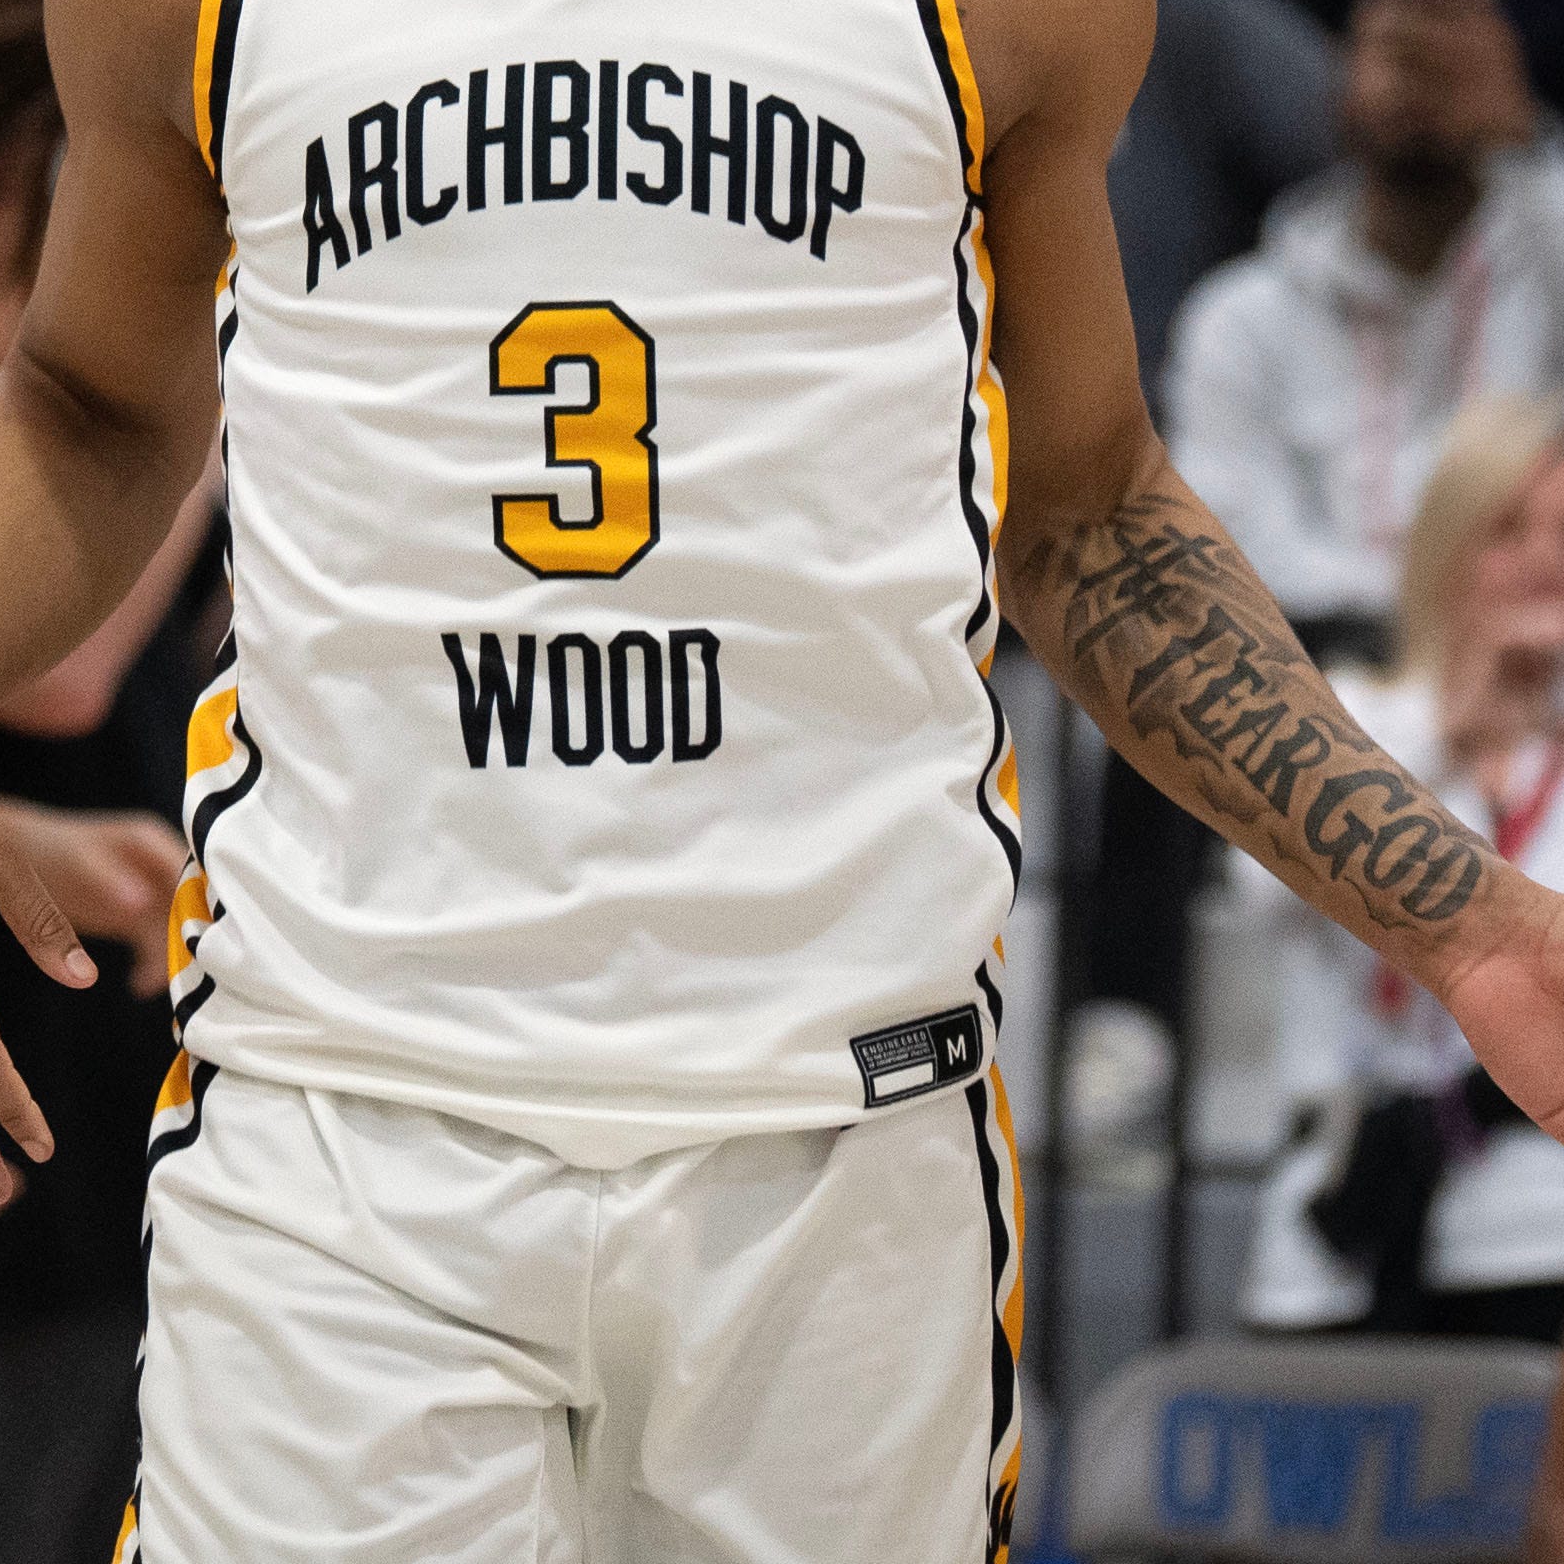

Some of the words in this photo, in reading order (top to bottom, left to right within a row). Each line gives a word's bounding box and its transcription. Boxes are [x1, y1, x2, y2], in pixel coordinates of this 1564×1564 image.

[303, 60, 865, 294] ARCHBISHOP
[489, 301, 660, 580] 3
[441, 628, 722, 769] WOOD
[1127, 605, 1329, 816] FEAR
[1305, 770, 1482, 920] GOD
[946, 1033, 967, 1066] M
